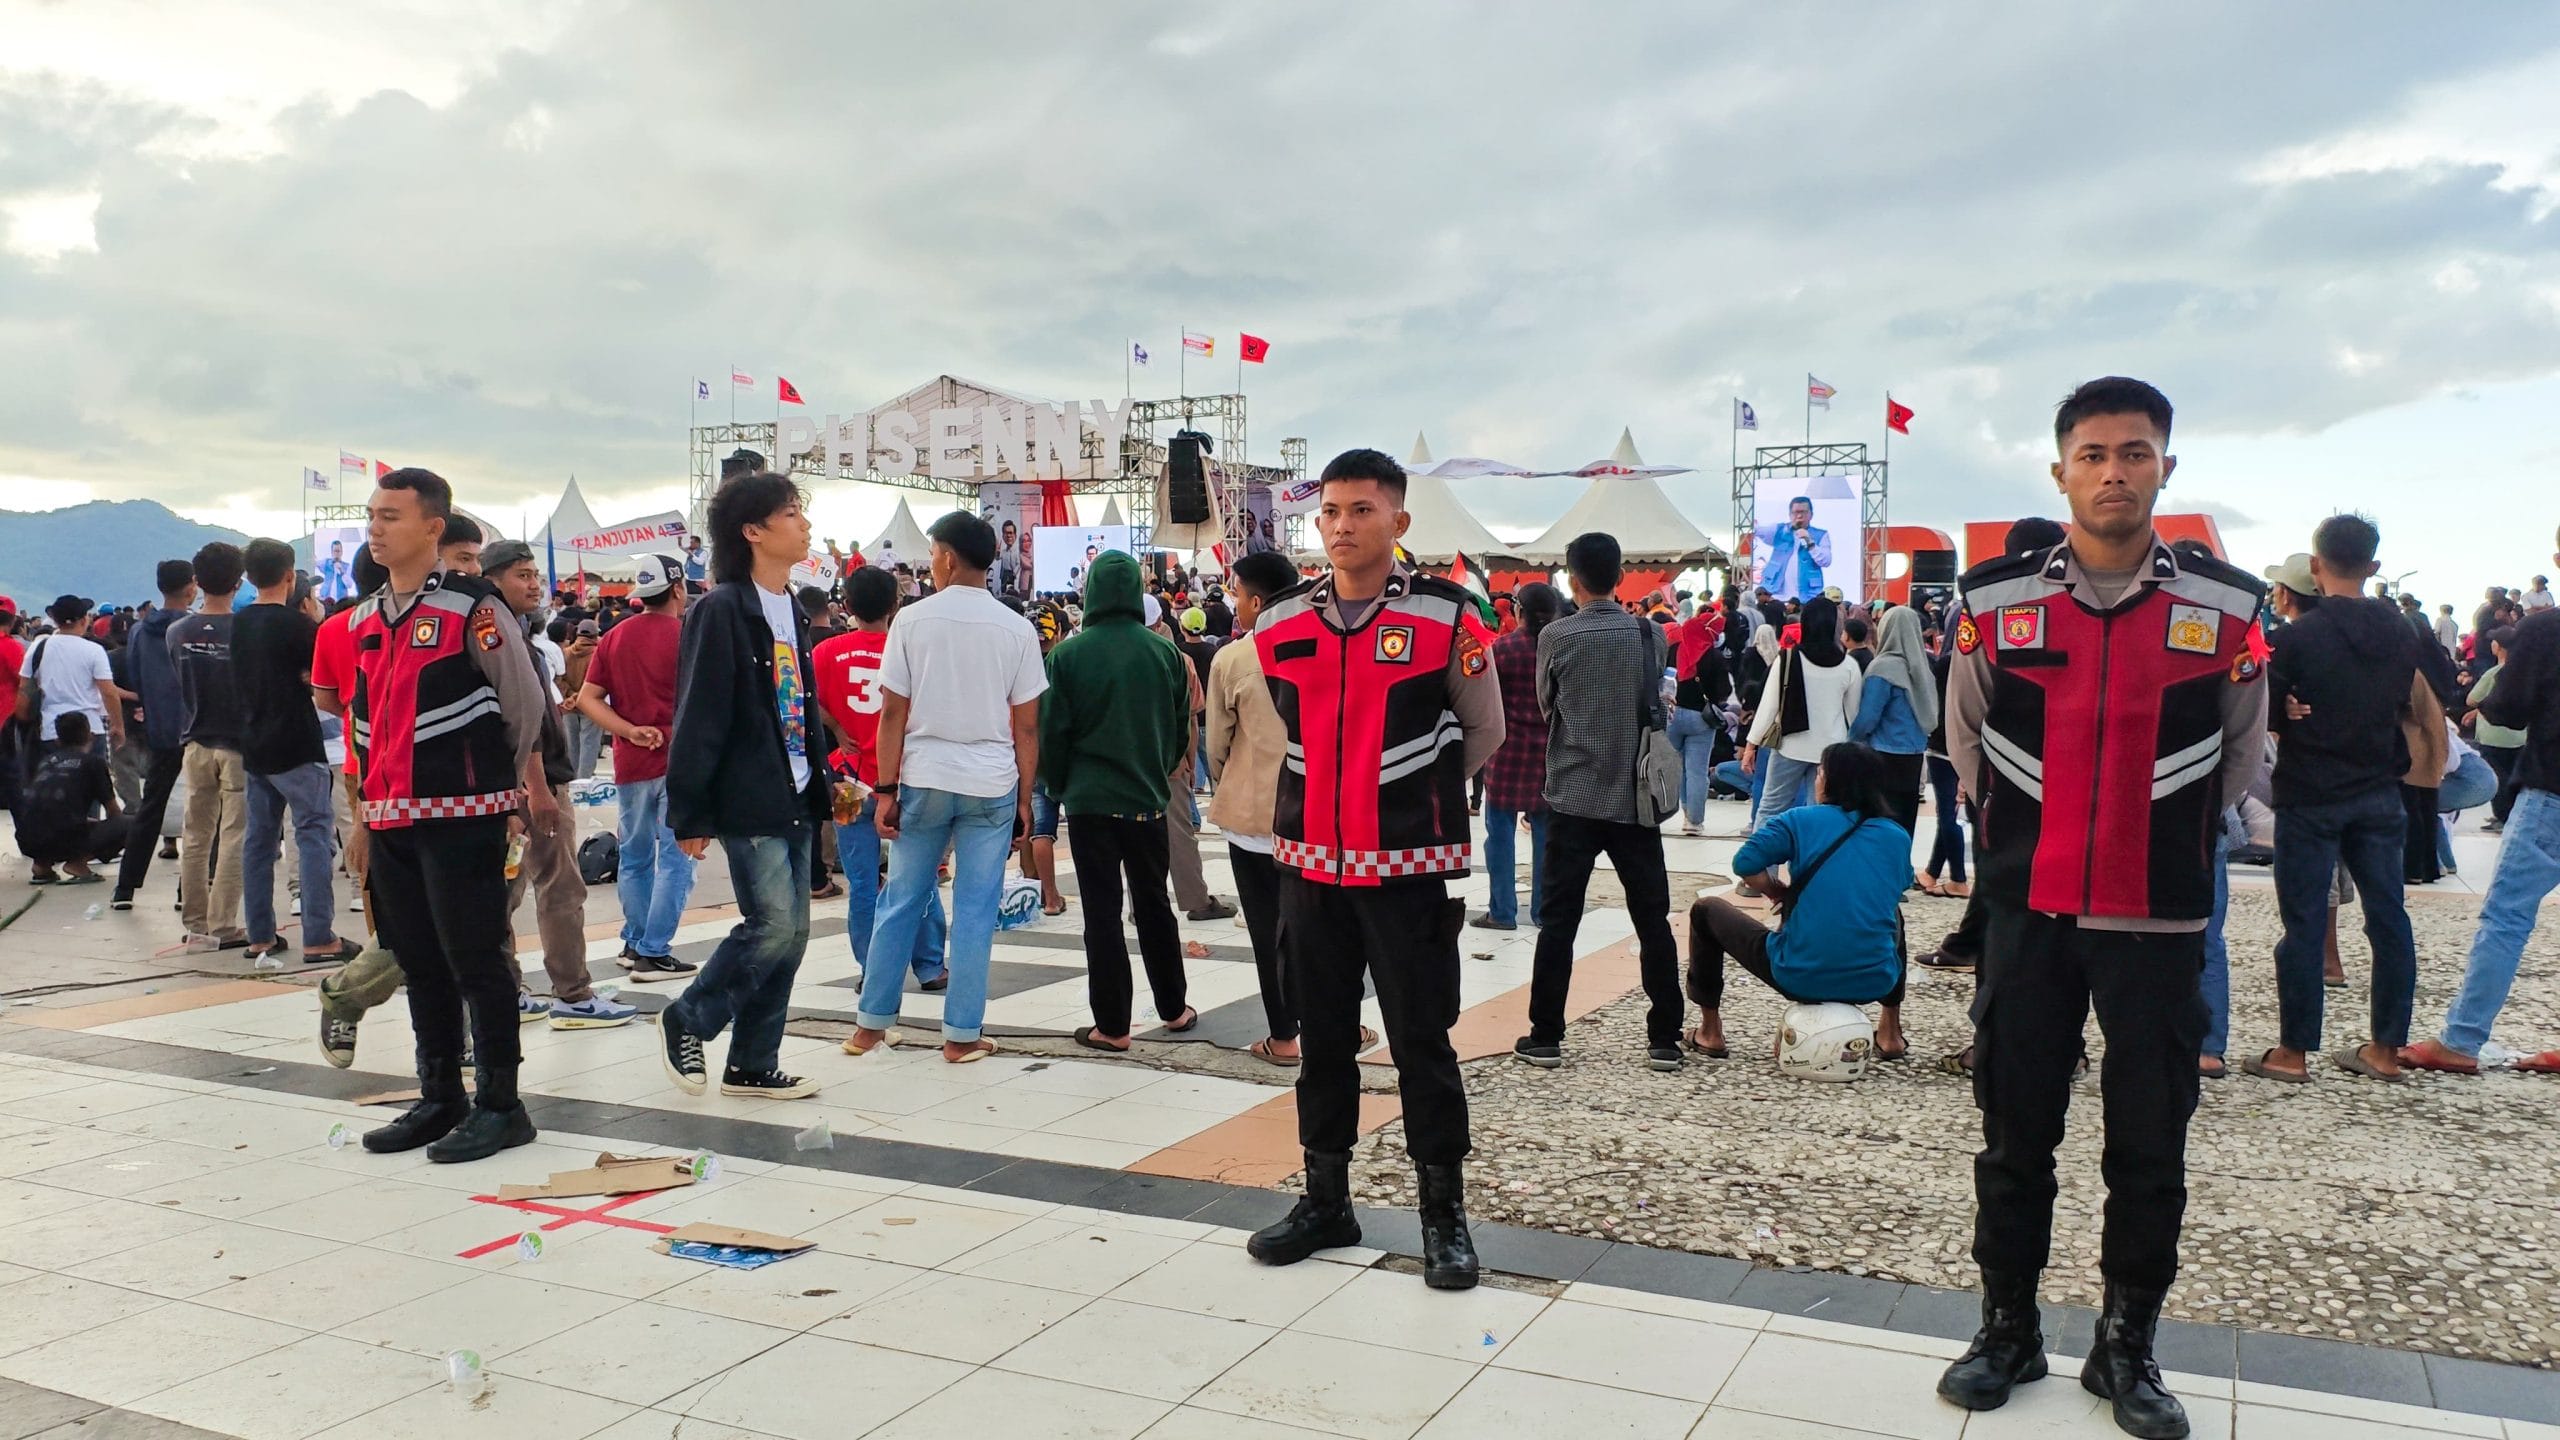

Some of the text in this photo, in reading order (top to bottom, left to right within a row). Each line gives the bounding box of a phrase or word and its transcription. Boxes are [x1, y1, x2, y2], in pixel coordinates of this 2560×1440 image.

[776, 399, 1135, 480] PHSENNY
[820, 566, 832, 578] 10
[847, 666, 883, 714] 3
